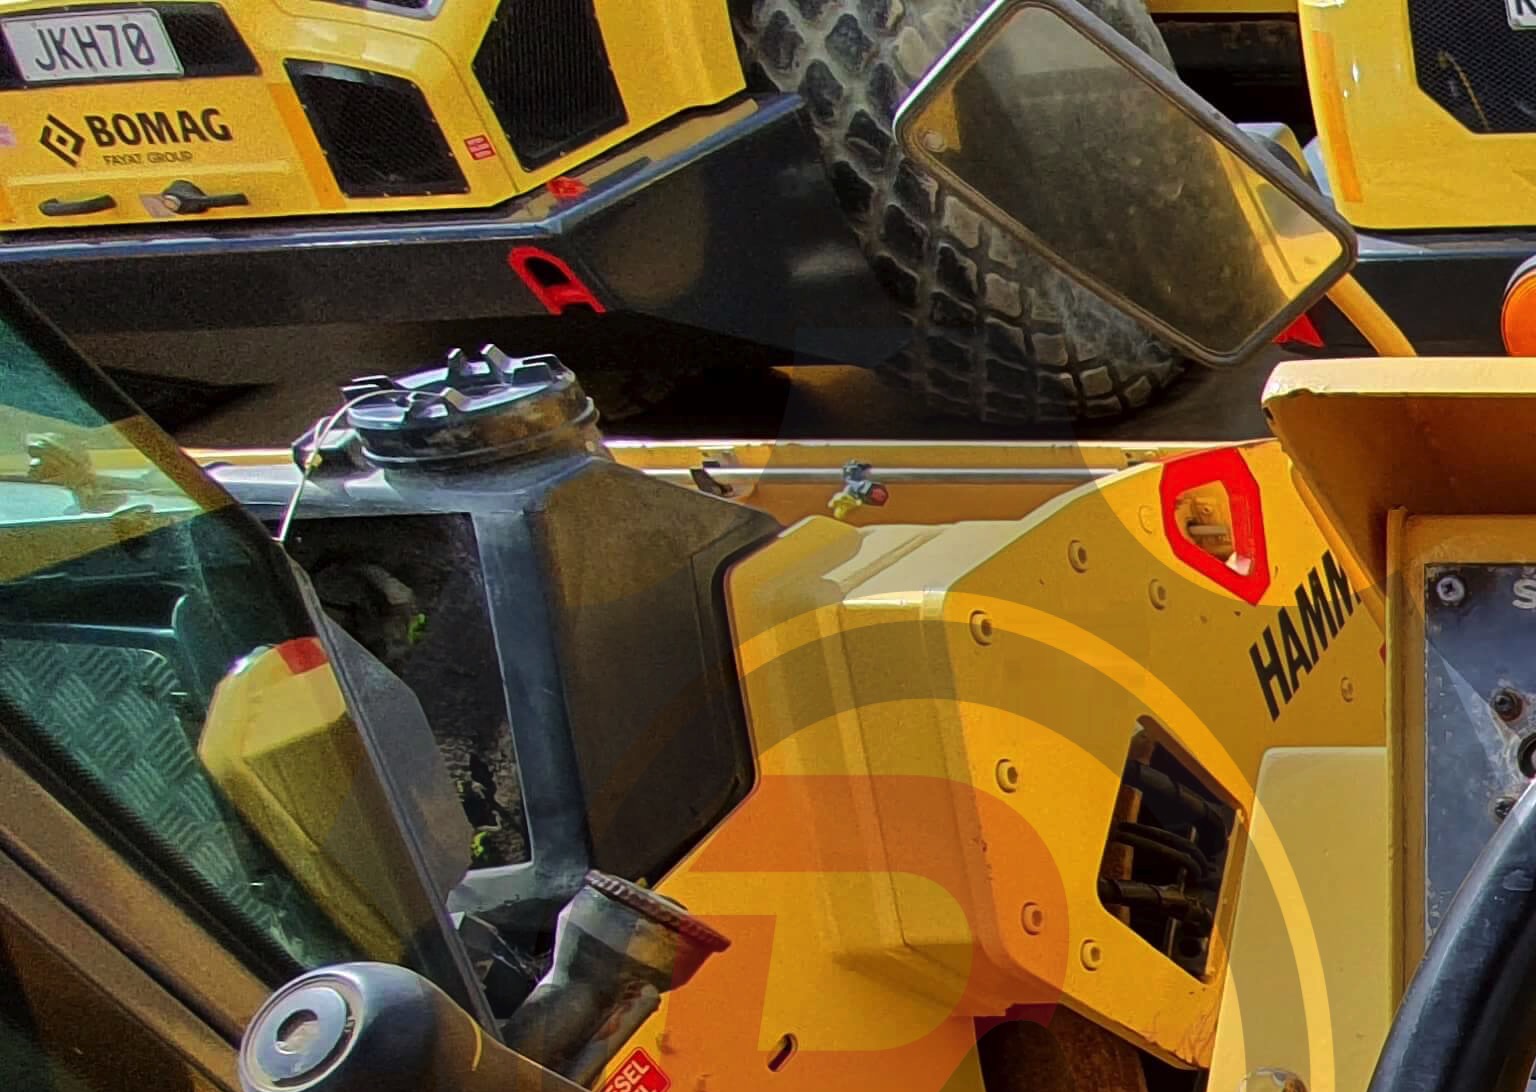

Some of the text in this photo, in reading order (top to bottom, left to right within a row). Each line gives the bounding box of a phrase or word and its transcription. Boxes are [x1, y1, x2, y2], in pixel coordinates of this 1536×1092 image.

[34, 23, 156, 71] JKH70
[84, 107, 234, 148] BOMAG
[103, 150, 193, 165] FAYAT GROUP
